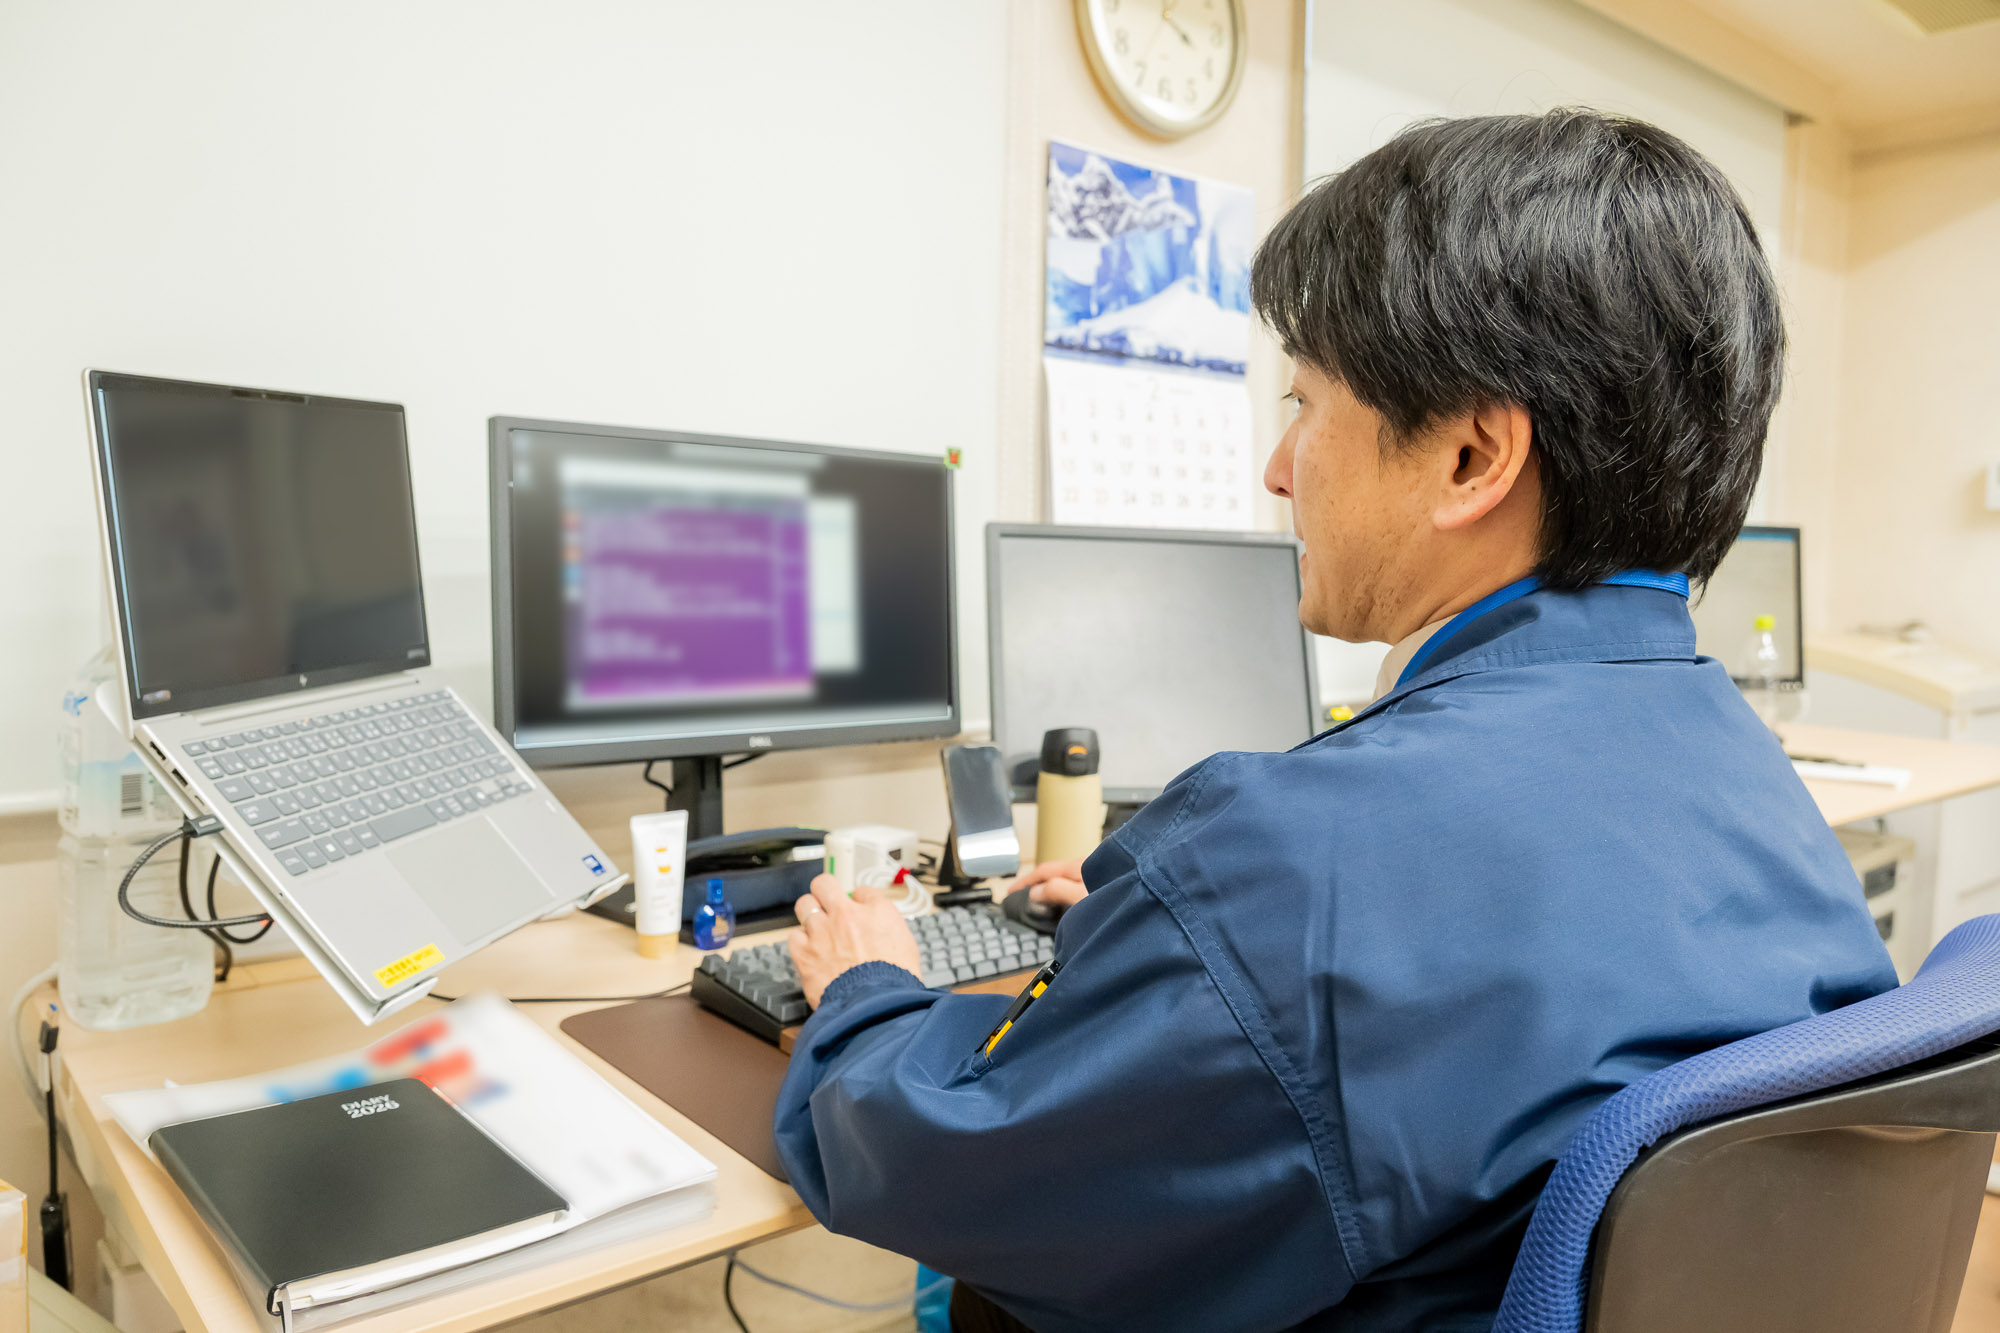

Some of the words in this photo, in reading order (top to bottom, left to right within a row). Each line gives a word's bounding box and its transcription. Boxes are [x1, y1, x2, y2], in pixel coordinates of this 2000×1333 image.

[1114, 27, 1129, 55] 8
[1134, 60, 1147, 87] 7
[1157, 76, 1173, 102] 6
[1184, 77, 1197, 103] 5
[341, 1094, 389, 1111] DIARY
[347, 1099, 400, 1119] 2026
